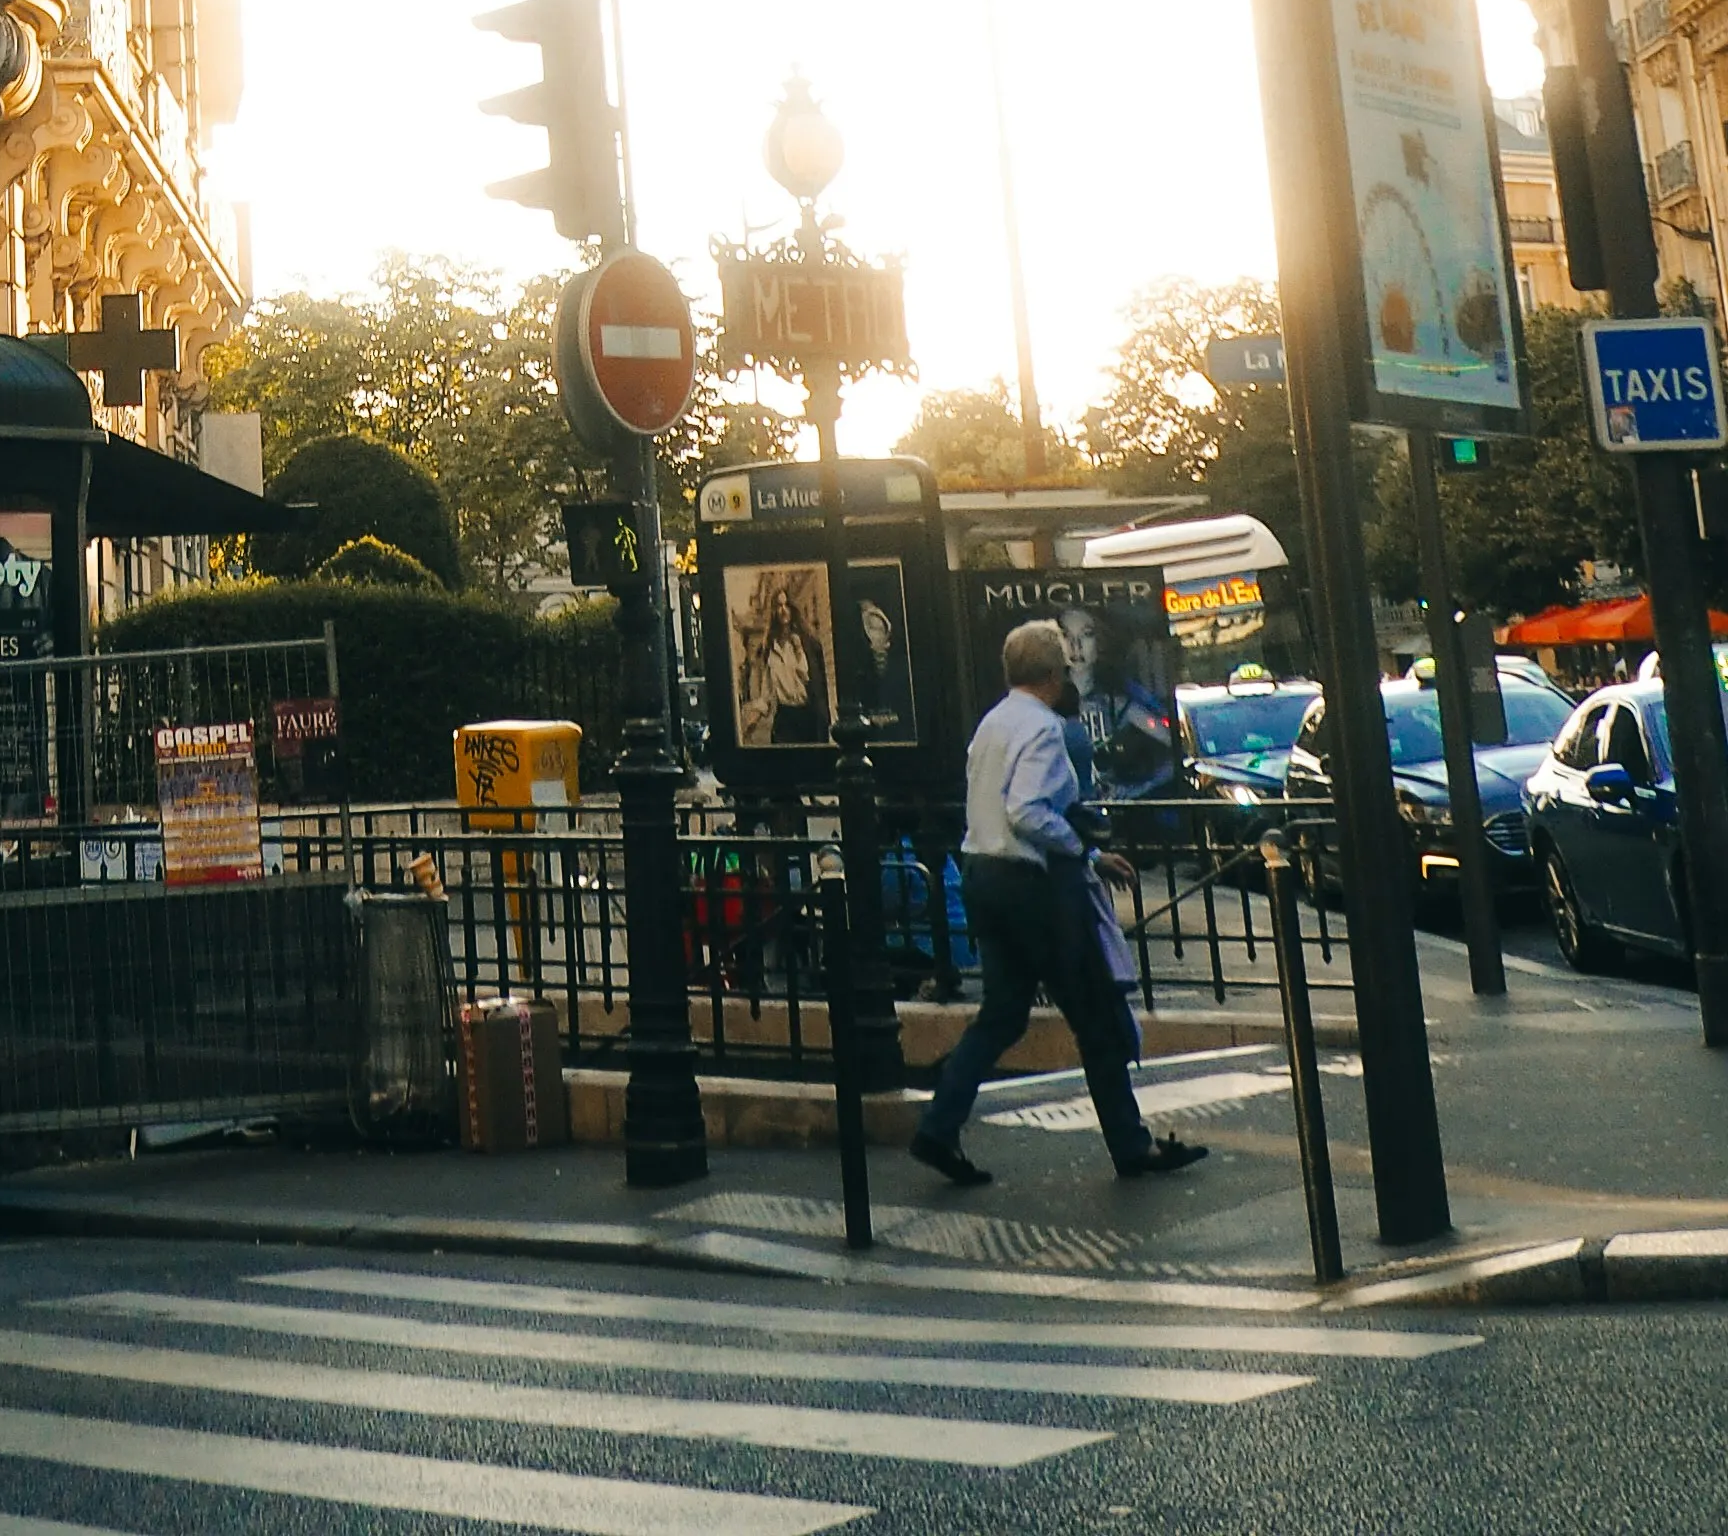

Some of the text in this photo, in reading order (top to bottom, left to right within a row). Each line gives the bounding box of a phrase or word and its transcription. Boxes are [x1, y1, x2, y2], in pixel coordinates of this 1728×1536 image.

[1244, 349, 1270, 369] La
[1604, 367, 1708, 403] TAXIS
[731, 495, 741, 509] 9
[757, 489, 776, 509] La
[985, 582, 1151, 610] MUGLER
[1165, 590, 1202, 614] Gare
[277, 707, 338, 730] FAURÉ
[157, 723, 251, 749] GOSPEL
